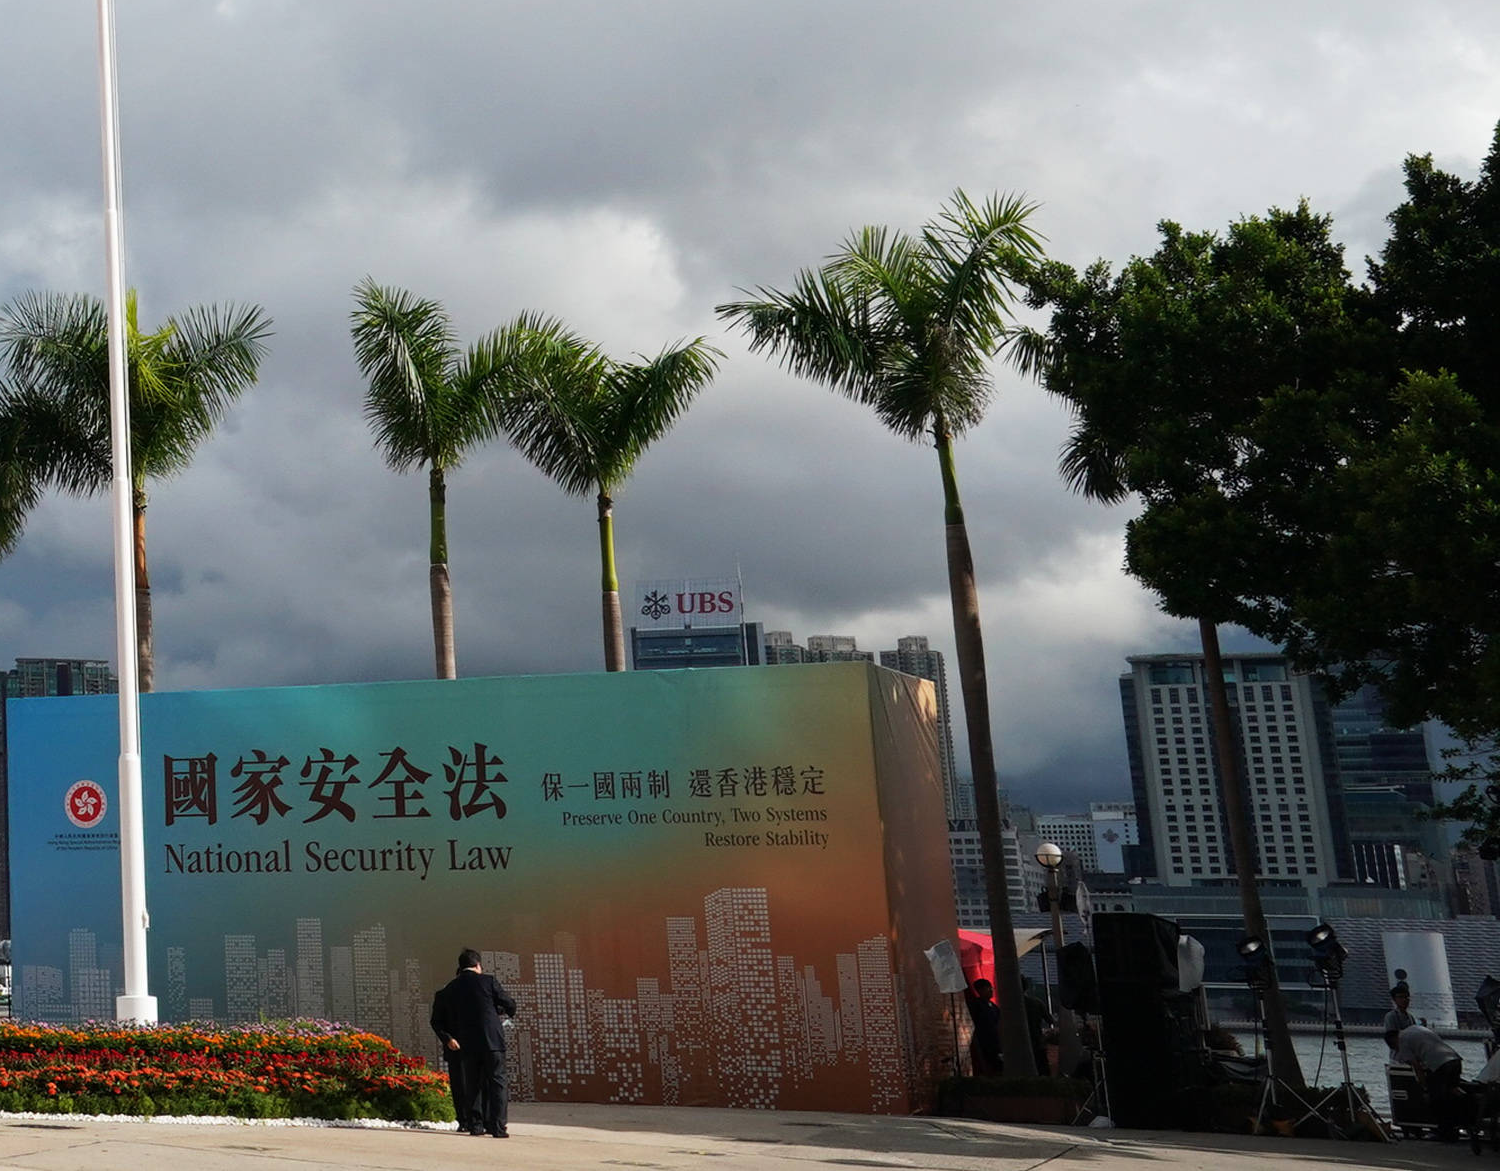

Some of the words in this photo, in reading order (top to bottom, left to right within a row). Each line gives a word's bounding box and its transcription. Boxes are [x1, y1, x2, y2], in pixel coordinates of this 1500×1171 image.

[676, 591, 734, 614] UBS
[163, 742, 509, 826] 國家安全法
[541, 769, 670, 802] 保一國兩制
[687, 765, 827, 798] 還香港穩定
[562, 811, 622, 826] Preserve
[628, 809, 657, 825] One
[662, 808, 726, 827] Country,
[731, 807, 761, 823] Two
[766, 806, 828, 826] Systems
[704, 832, 760, 848] Restore
[765, 829, 829, 850] Stability
[164, 839, 293, 874] National
[305, 839, 436, 881] Security
[448, 839, 514, 872] Law
